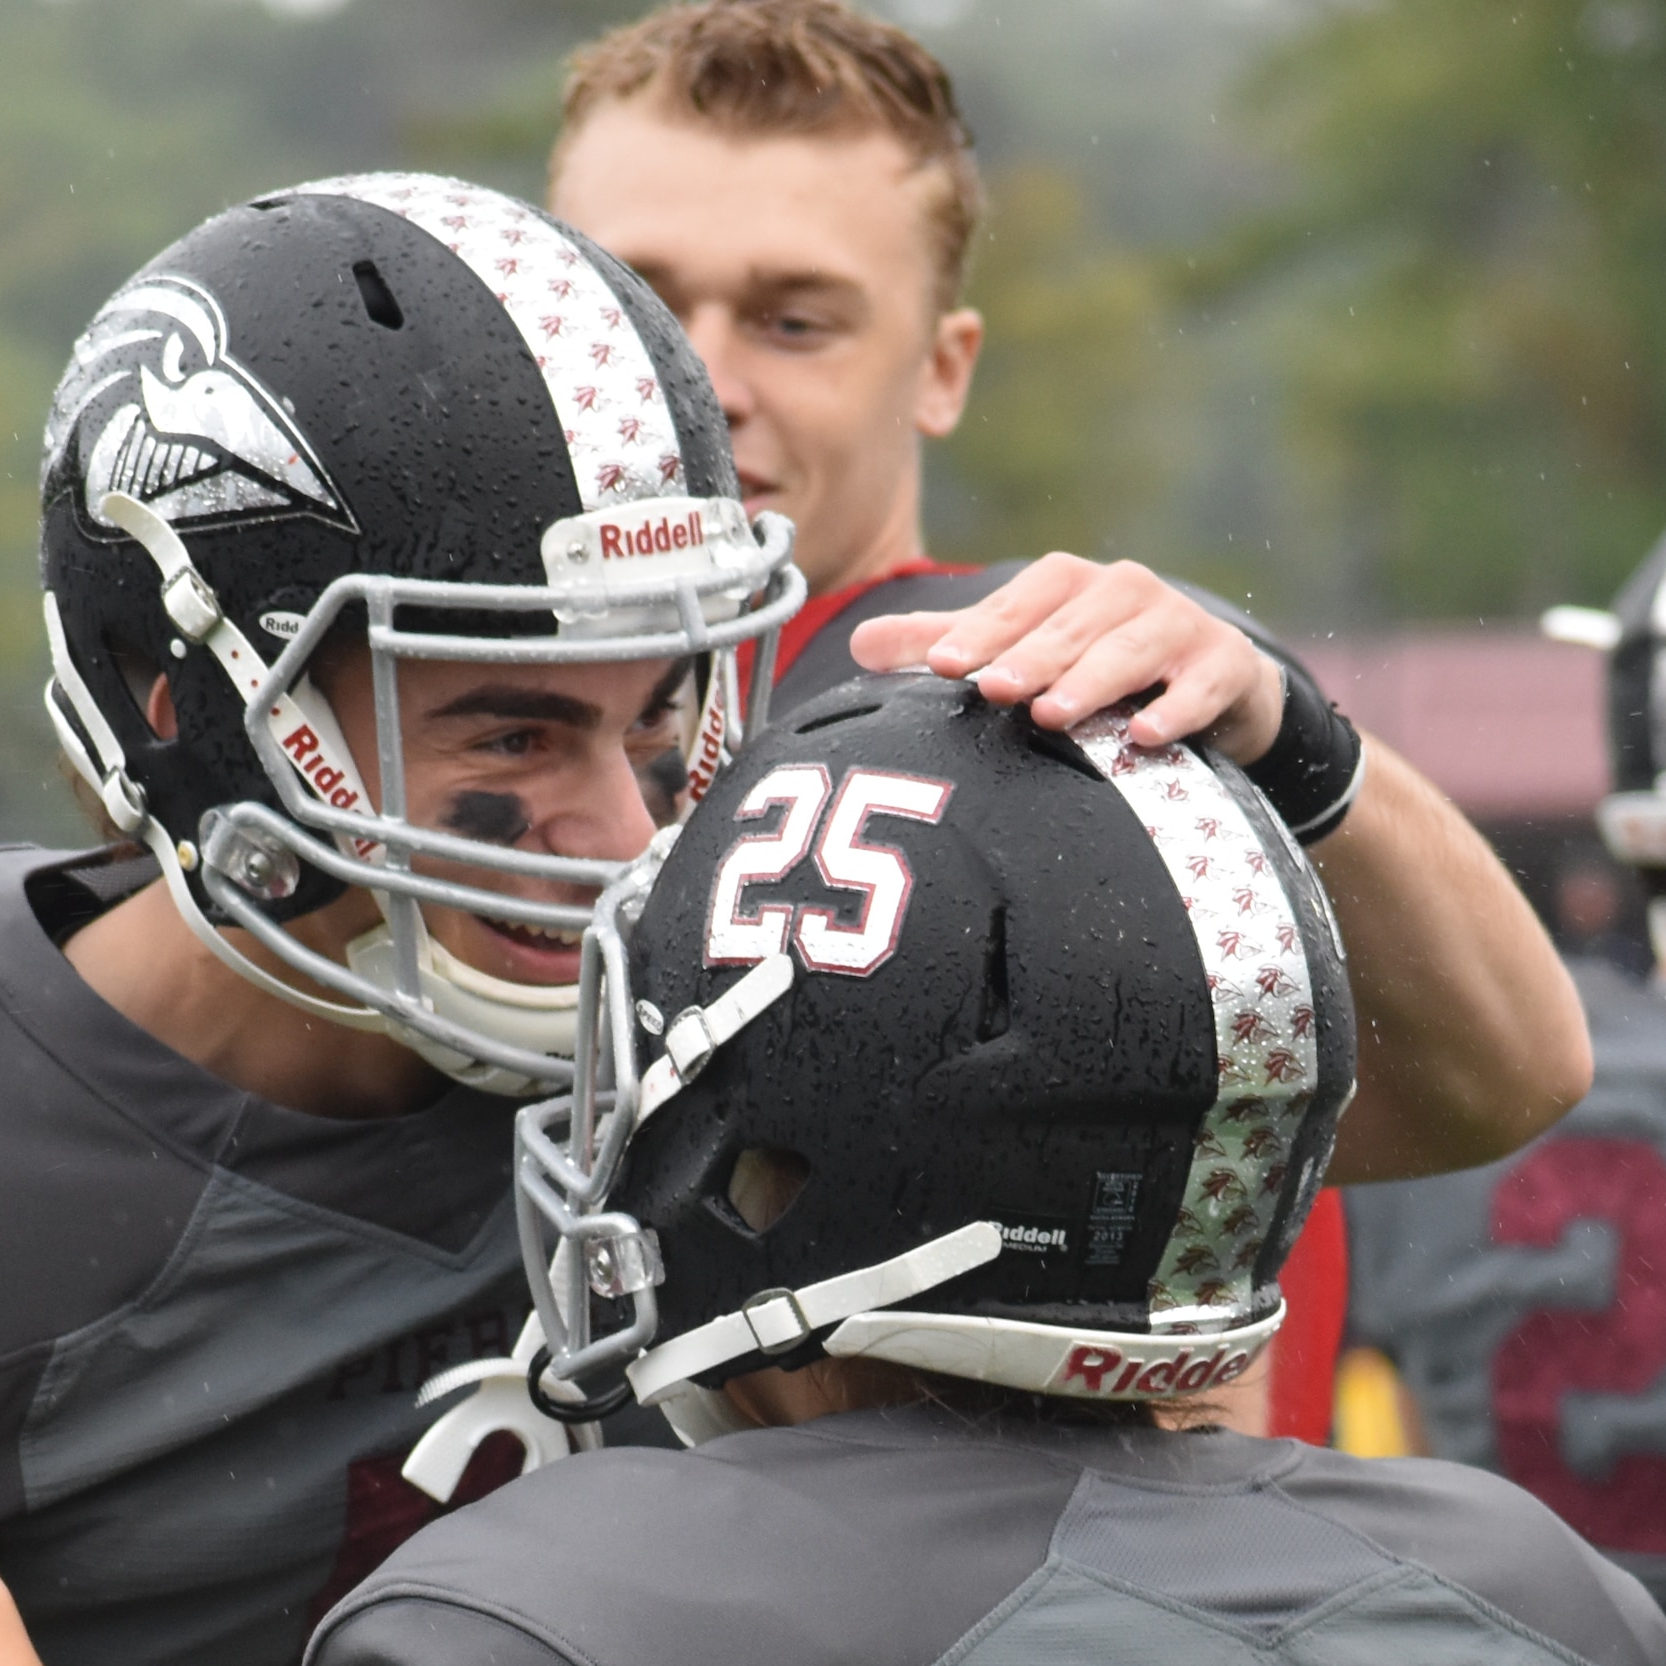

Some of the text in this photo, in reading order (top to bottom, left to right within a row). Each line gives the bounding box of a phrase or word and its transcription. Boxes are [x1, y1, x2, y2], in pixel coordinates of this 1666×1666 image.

[599, 510, 704, 558] Riddell
[265, 617, 300, 634] Ridd
[689, 690, 724, 802] Ridd
[703, 763, 957, 978] 25
[1059, 1345, 1249, 1393] Ridde
